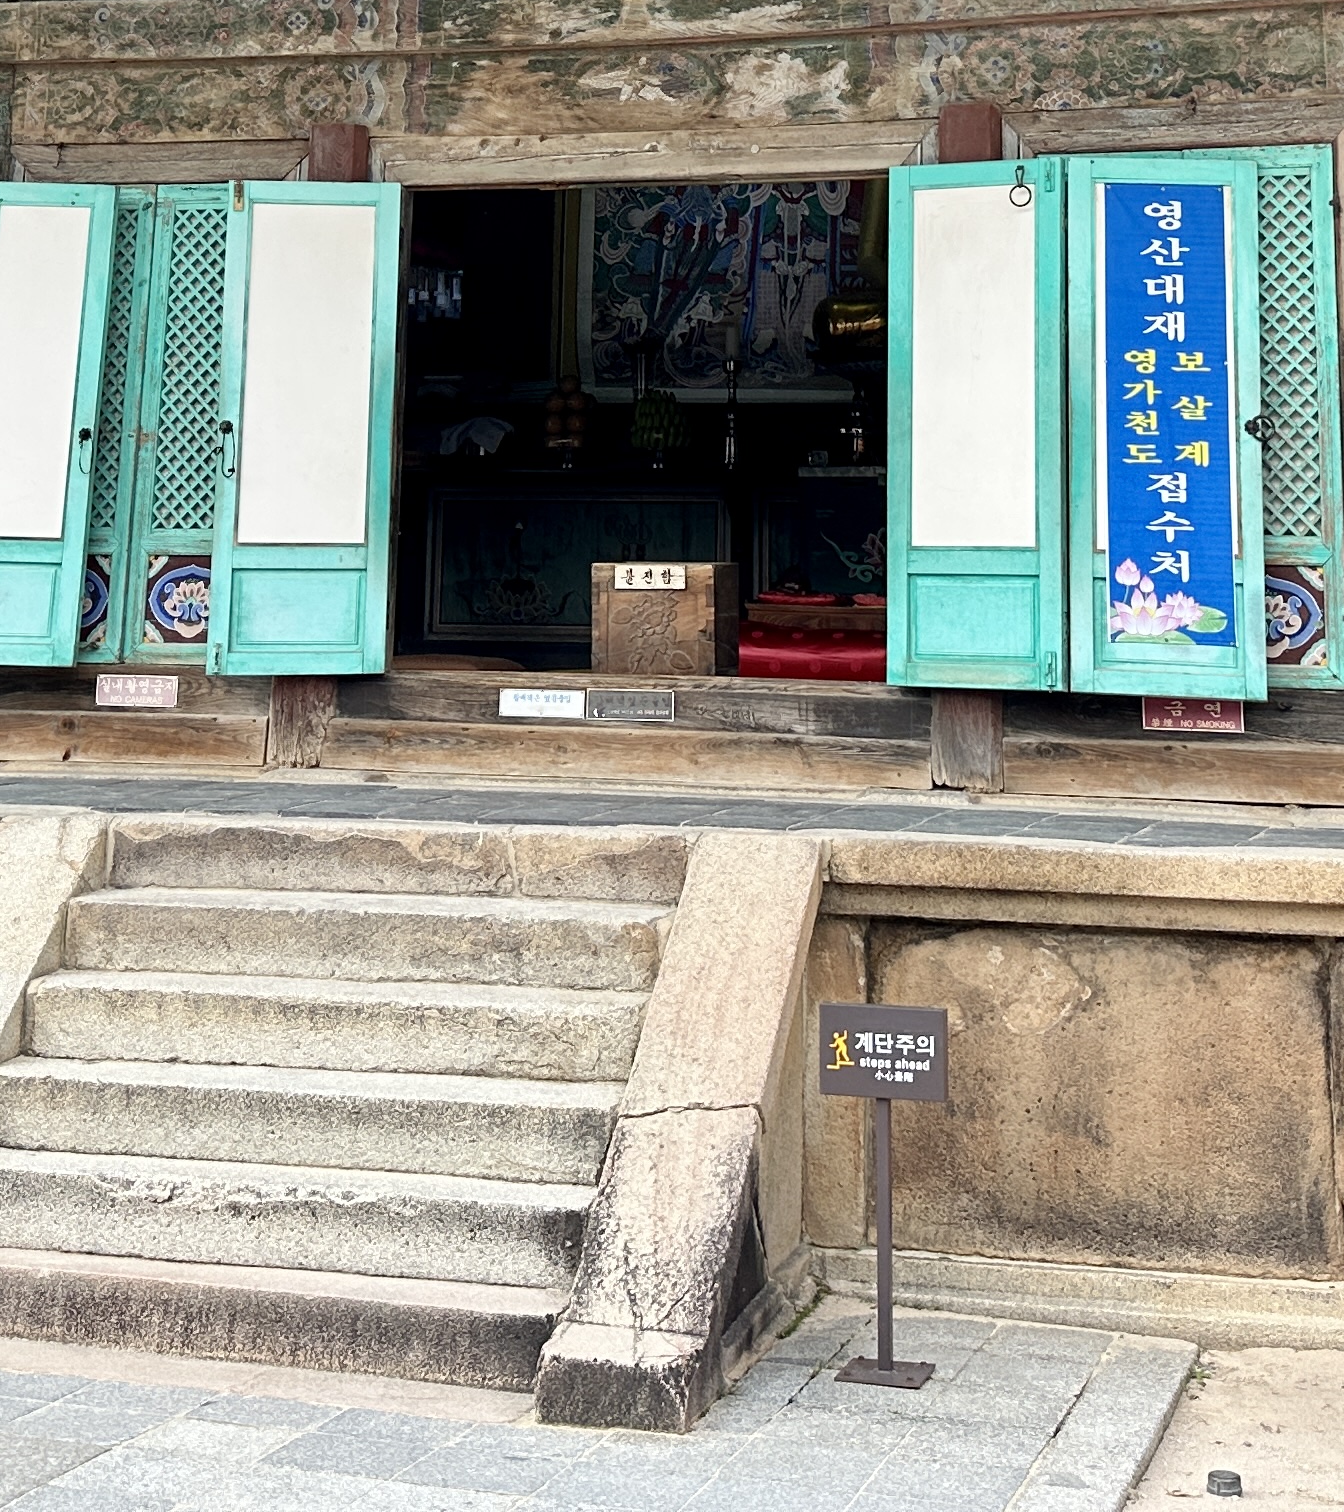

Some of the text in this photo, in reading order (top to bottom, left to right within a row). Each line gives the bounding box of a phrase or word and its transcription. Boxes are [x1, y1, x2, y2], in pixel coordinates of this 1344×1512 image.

[1139, 200, 1191, 343] 영산대재
[1122, 348, 1163, 466] 영가천도
[1170, 349, 1214, 468] 보살계
[1144, 472, 1196, 583] 접수처
[109, 695, 164, 705] NO CAMERAS
[1180, 719, 1194, 728] NO
[1196, 719, 1236, 729] SMOKING
[854, 1031, 935, 1058] 계단주의
[859, 1057, 930, 1071] steps ahead
